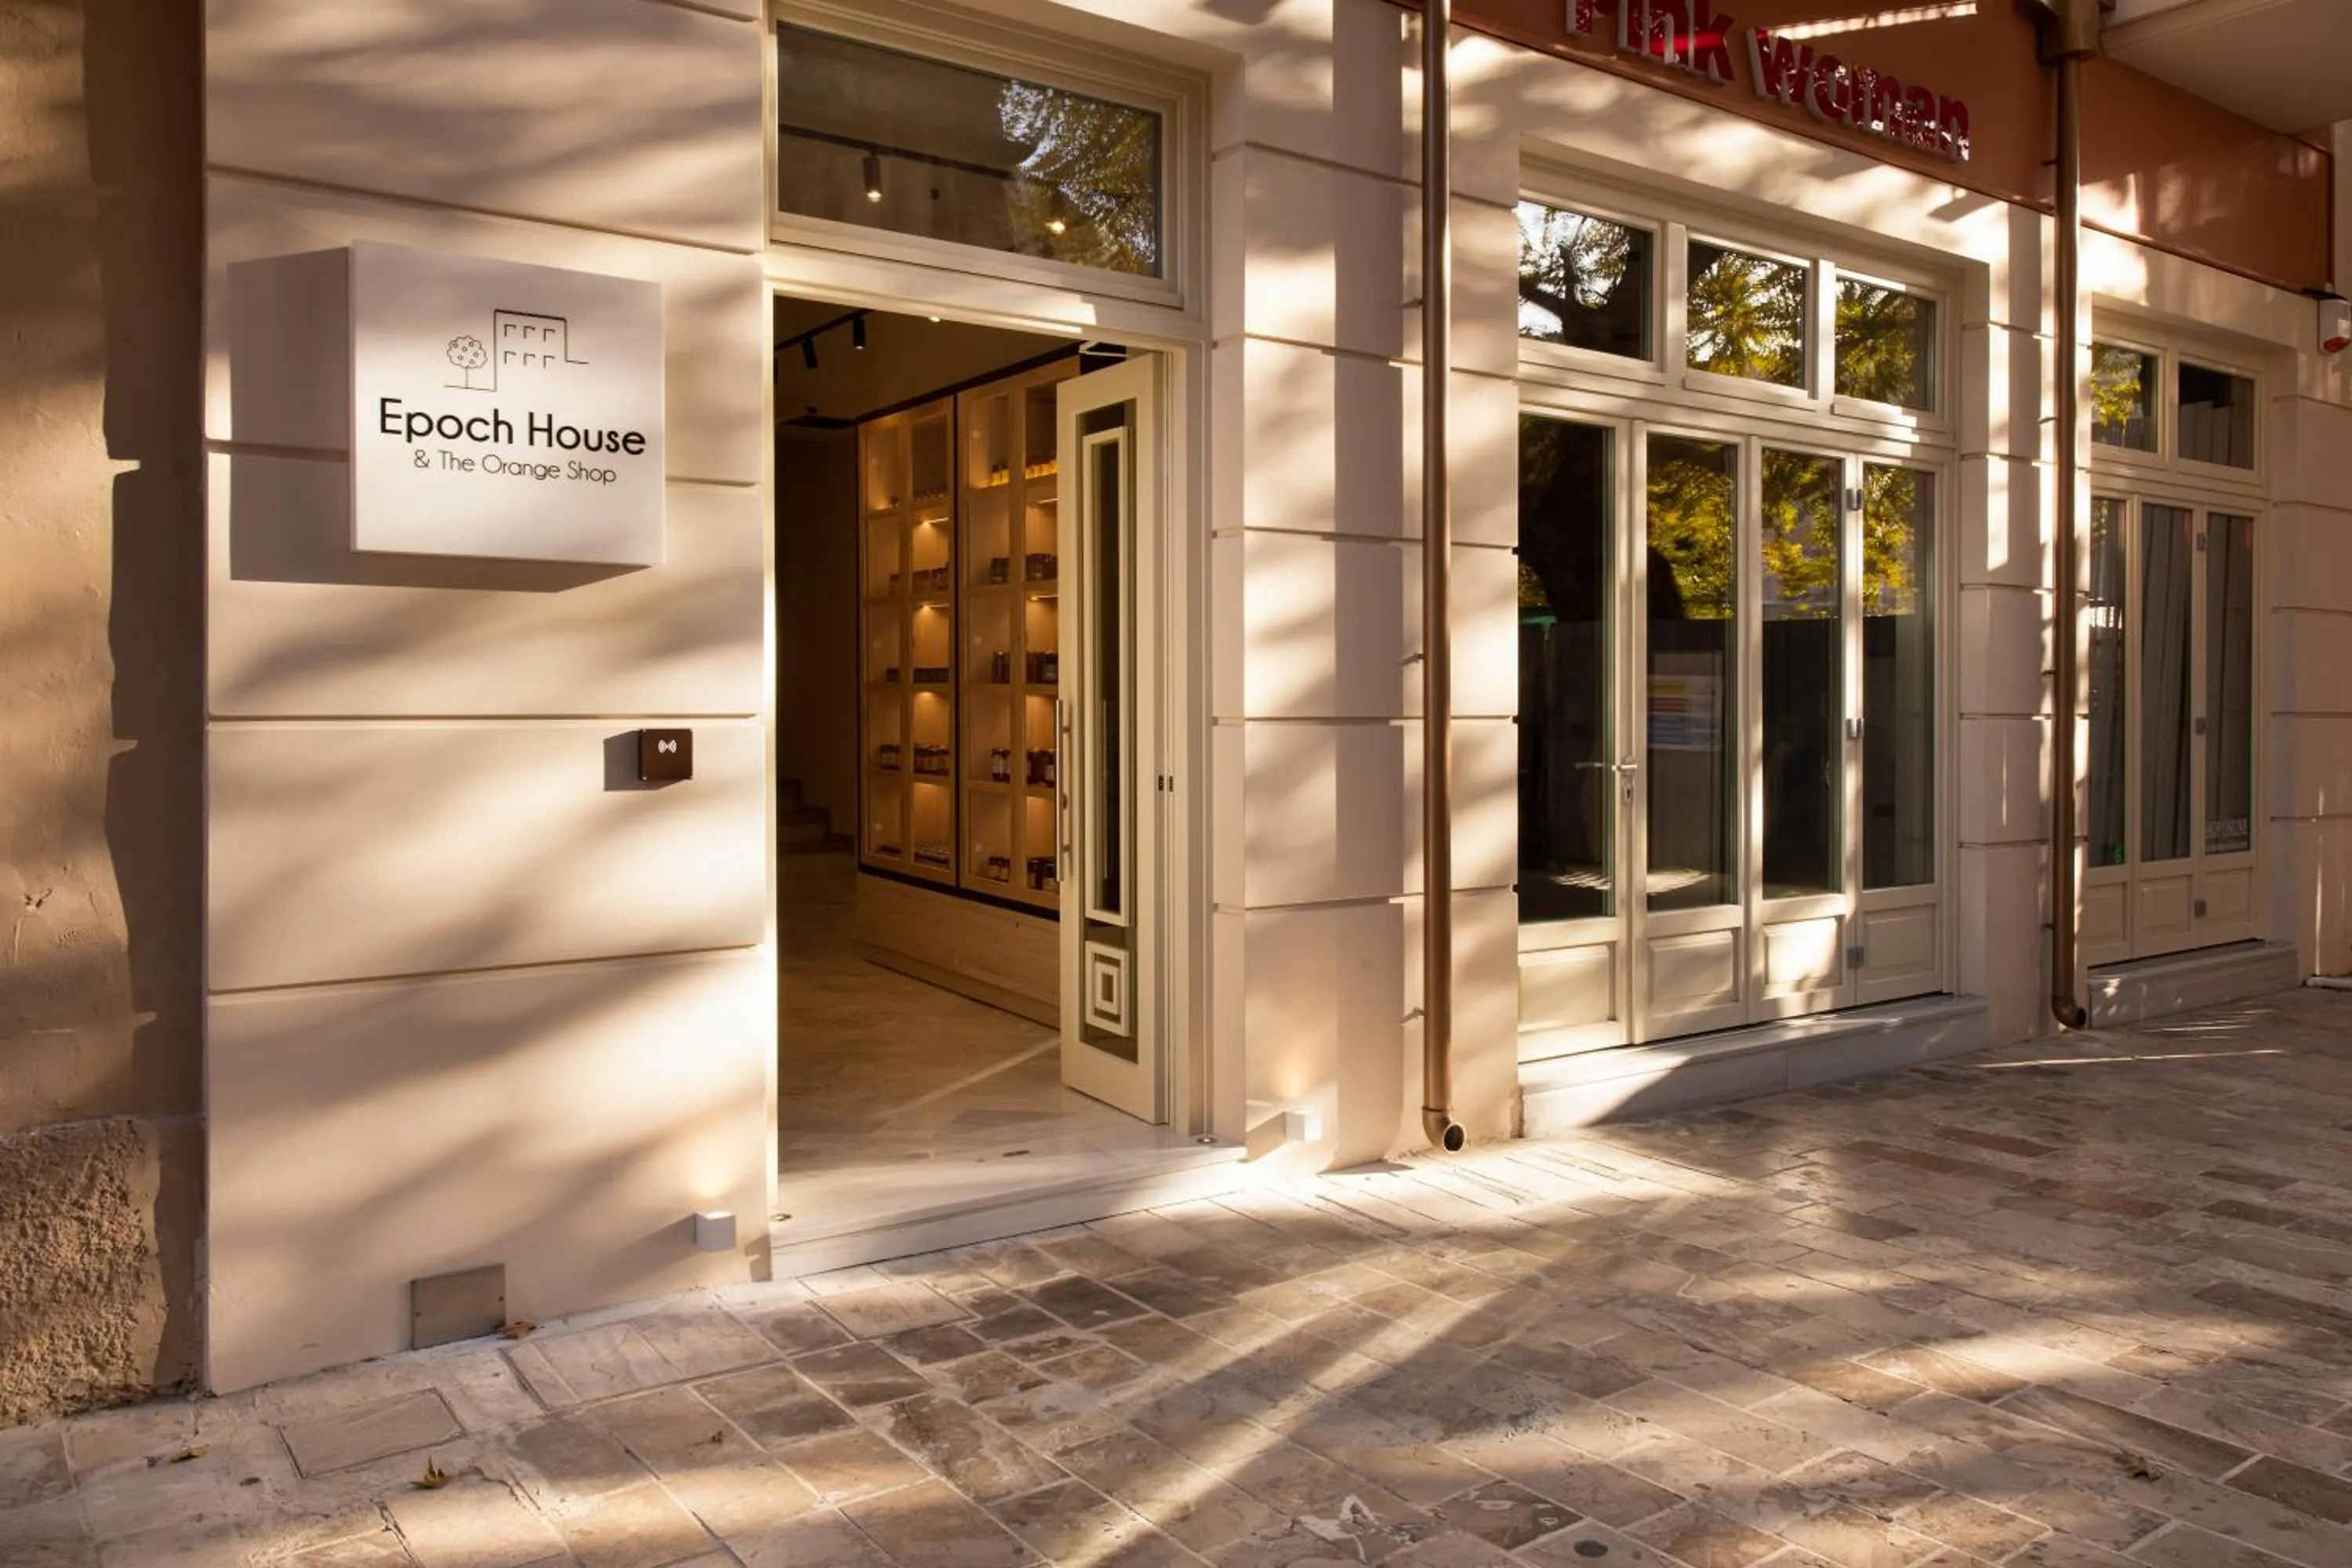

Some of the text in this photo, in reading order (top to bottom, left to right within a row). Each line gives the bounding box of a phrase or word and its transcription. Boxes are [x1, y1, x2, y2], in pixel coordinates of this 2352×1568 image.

[1746, 27, 1969, 163] Woman
[379, 397, 647, 456] Epoch House
[413, 449, 618, 487] & The Orange Shop
